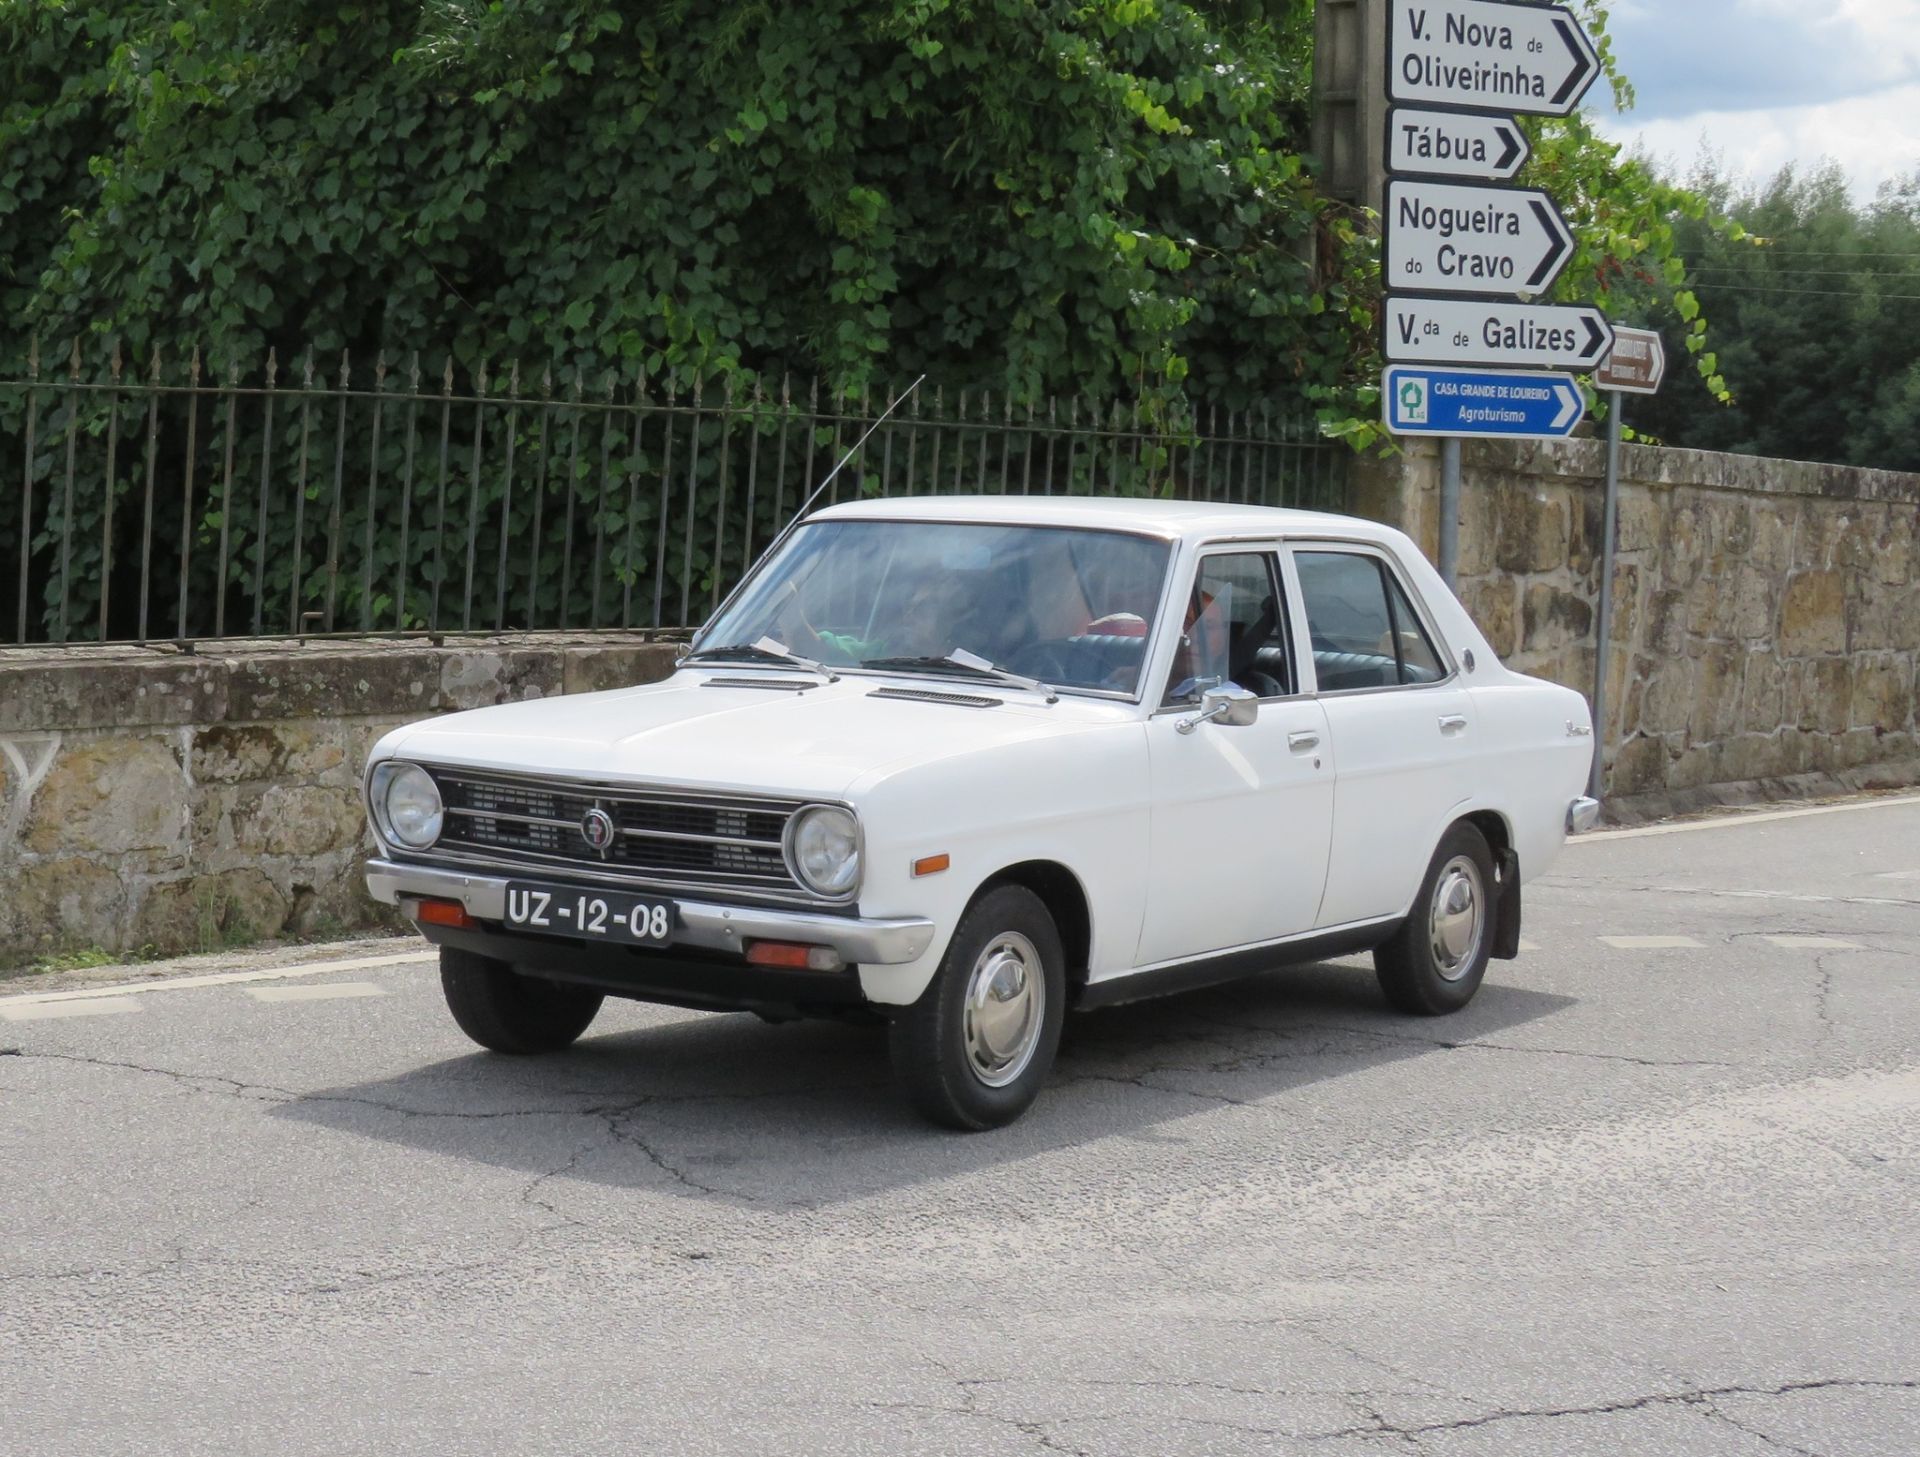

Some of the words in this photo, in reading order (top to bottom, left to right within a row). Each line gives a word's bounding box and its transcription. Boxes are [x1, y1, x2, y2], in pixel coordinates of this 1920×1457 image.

[1408, 8, 1431, 41] V.
[1445, 13, 1513, 50] Nova
[1527, 37, 1543, 53] de
[1402, 53, 1545, 98] Oliveirinha
[1402, 125, 1486, 162] Tábua
[1400, 197, 1520, 237] Nogueira
[1405, 258, 1422, 274] do
[1437, 244, 1514, 279] Cravo
[1453, 331, 1469, 347] de
[1483, 317, 1576, 351] Galizes
[1434, 382, 1458, 395] CASA
[1460, 384, 1496, 398] GRANDE
[1497, 386, 1510, 399] DE
[1510, 387, 1550, 401] LOUREIRO
[1458, 405, 1526, 423] Agroturismo
